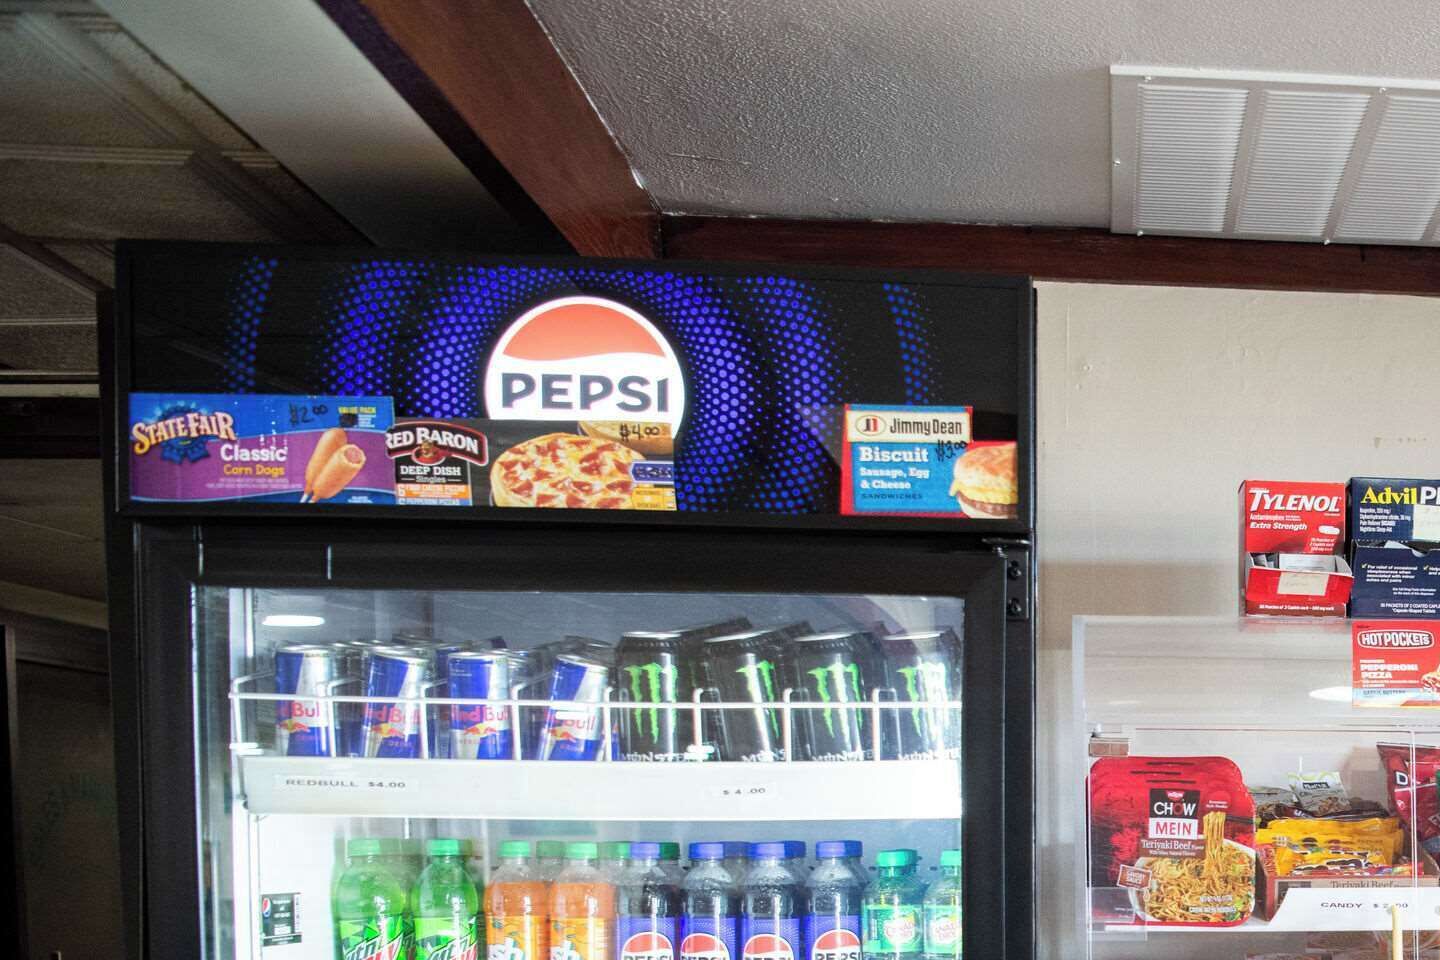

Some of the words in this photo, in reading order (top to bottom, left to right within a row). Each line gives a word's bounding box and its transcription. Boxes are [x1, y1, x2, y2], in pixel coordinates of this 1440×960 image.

[501, 372, 670, 413] PEPSI
[132, 416, 190, 455] STATE
[186, 411, 237, 441] FAIR
[890, 418, 931, 435] Jimmy
[933, 419, 962, 434] Dean
[416, 427, 479, 455] BARON
[220, 444, 287, 462] Classic
[859, 446, 929, 463] Biscuit
[224, 464, 253, 476] Corn
[255, 464, 285, 478] Dogs
[400, 466, 431, 476] DEEP
[433, 466, 462, 476] DISH
[909, 467, 930, 479] Egg
[415, 475, 447, 484] Singles
[860, 480, 869, 489] &
[872, 479, 911, 490] Cheese
[1249, 488, 1341, 512] TYLENOL
[1361, 484, 1417, 505] Advil
[1250, 521, 1271, 530] Extra
[1273, 521, 1308, 532] Strength
[1360, 663, 1419, 671] PEPPERONI
[286, 778, 360, 787] REDBULL
[1154, 801, 1196, 816] CHOW
[1155, 821, 1193, 836] MEIN
[1141, 840, 1172, 851] Teriyaki
[1173, 841, 1192, 850] Beef
